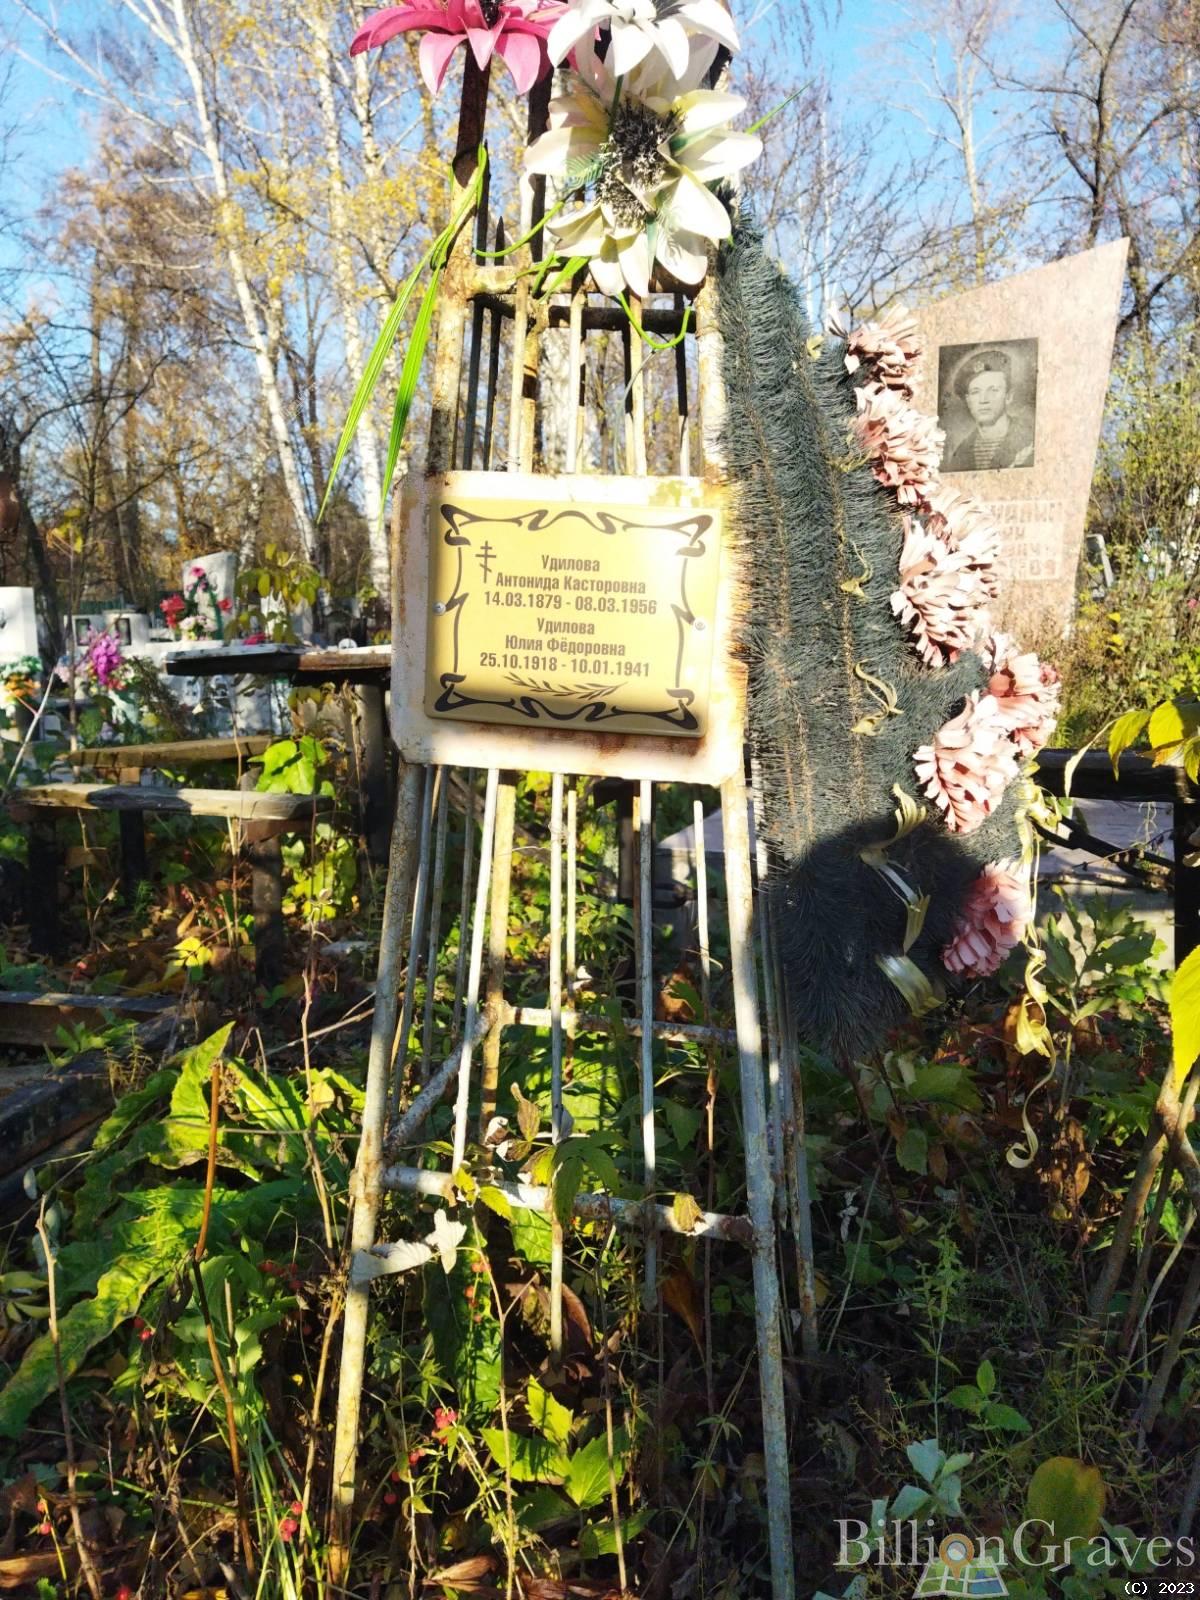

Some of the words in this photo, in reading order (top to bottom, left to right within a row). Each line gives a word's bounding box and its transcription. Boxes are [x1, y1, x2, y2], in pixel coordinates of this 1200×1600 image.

[541, 554, 601, 572] Удилова
[495, 572, 560, 590] Антонида
[563, 575, 646, 595] Касторовна
[484, 591, 562, 609] 14.03.1879
[575, 597, 657, 615] 08.03.1956
[537, 618, 595, 635] Удилова
[505, 635, 543, 651] Юлия
[547, 637, 626, 657] Фёдоровна
[480, 652, 558, 671] 25.10.1918
[572, 659, 650, 677] 10.01.1941
